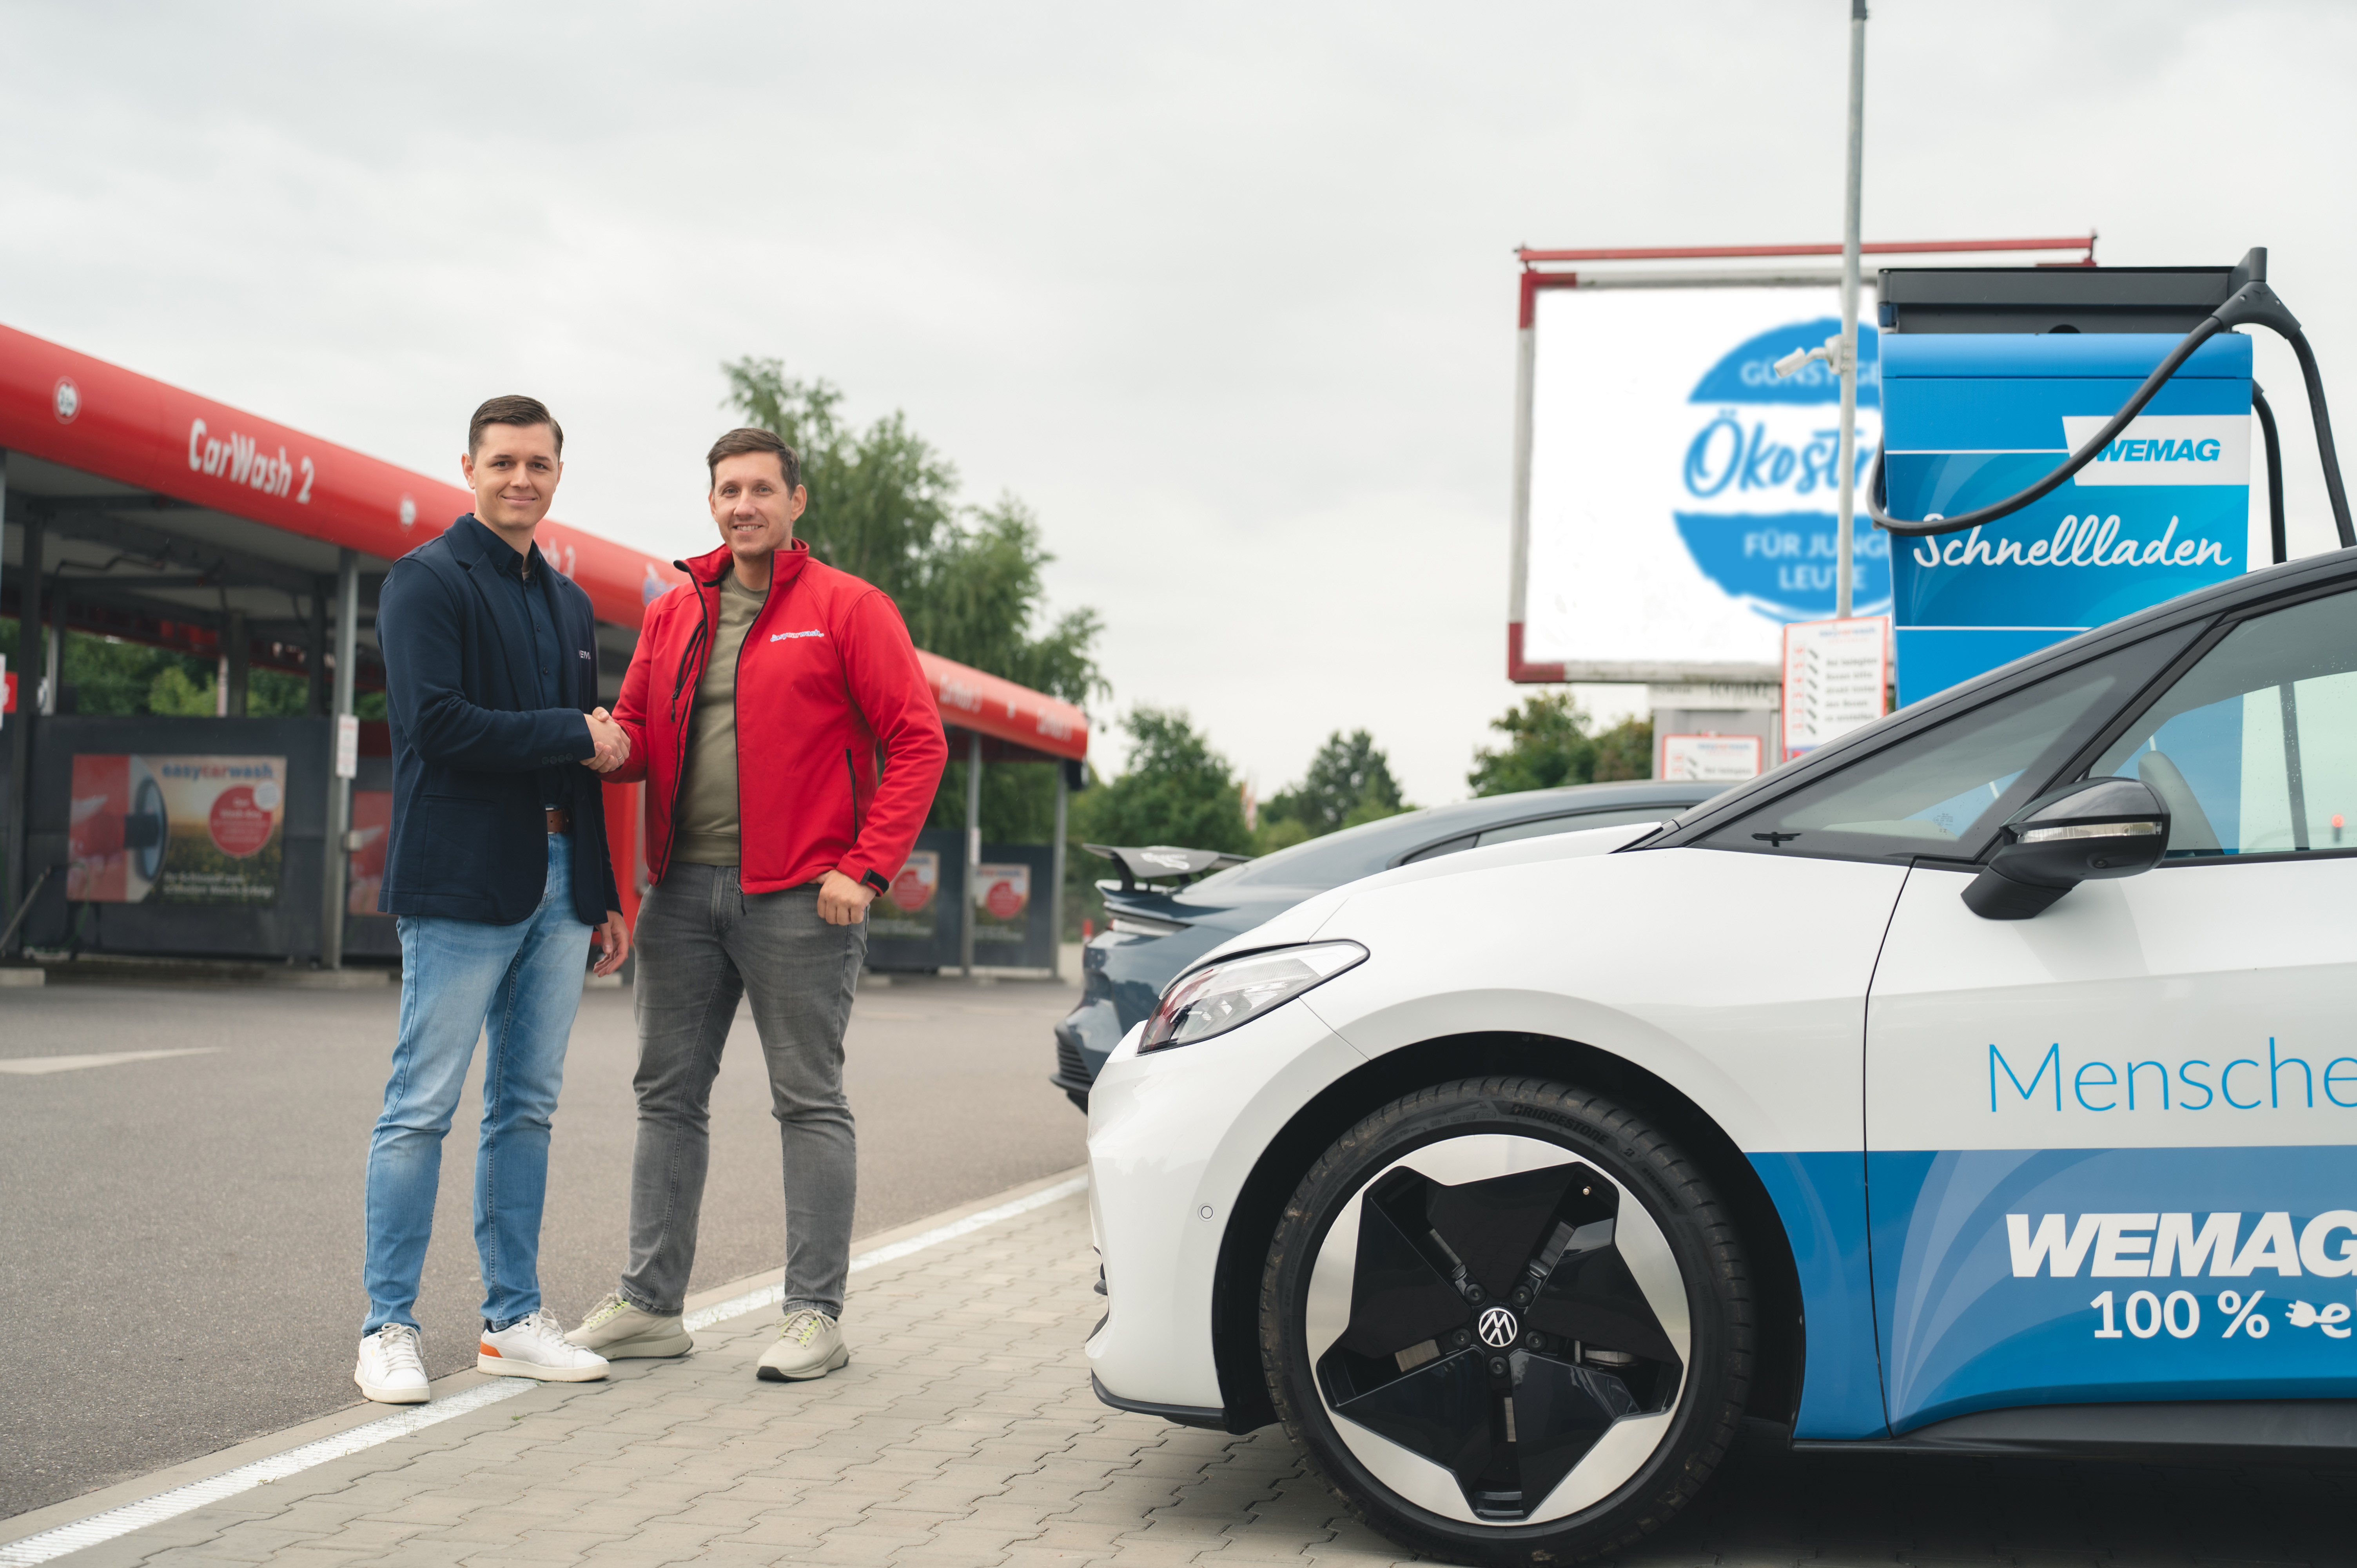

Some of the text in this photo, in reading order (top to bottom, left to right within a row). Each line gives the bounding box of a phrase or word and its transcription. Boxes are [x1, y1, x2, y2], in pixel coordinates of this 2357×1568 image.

[189, 417, 315, 505] CarWash 2
[1683, 408, 1882, 498] Ökostr
[2096, 439, 2221, 461] WEMAG
[1744, 527, 1889, 558] FÜR JUNG
[1913, 513, 2232, 567] Schnellladen
[1989, 1037, 2357, 1112] Mensche
[1508, 1103, 1609, 1145] BRIDGESTONE
[2006, 1209, 2357, 1278] WEMAG
[2090, 1290, 2200, 1340] 100
[2217, 1290, 2270, 1339] %
